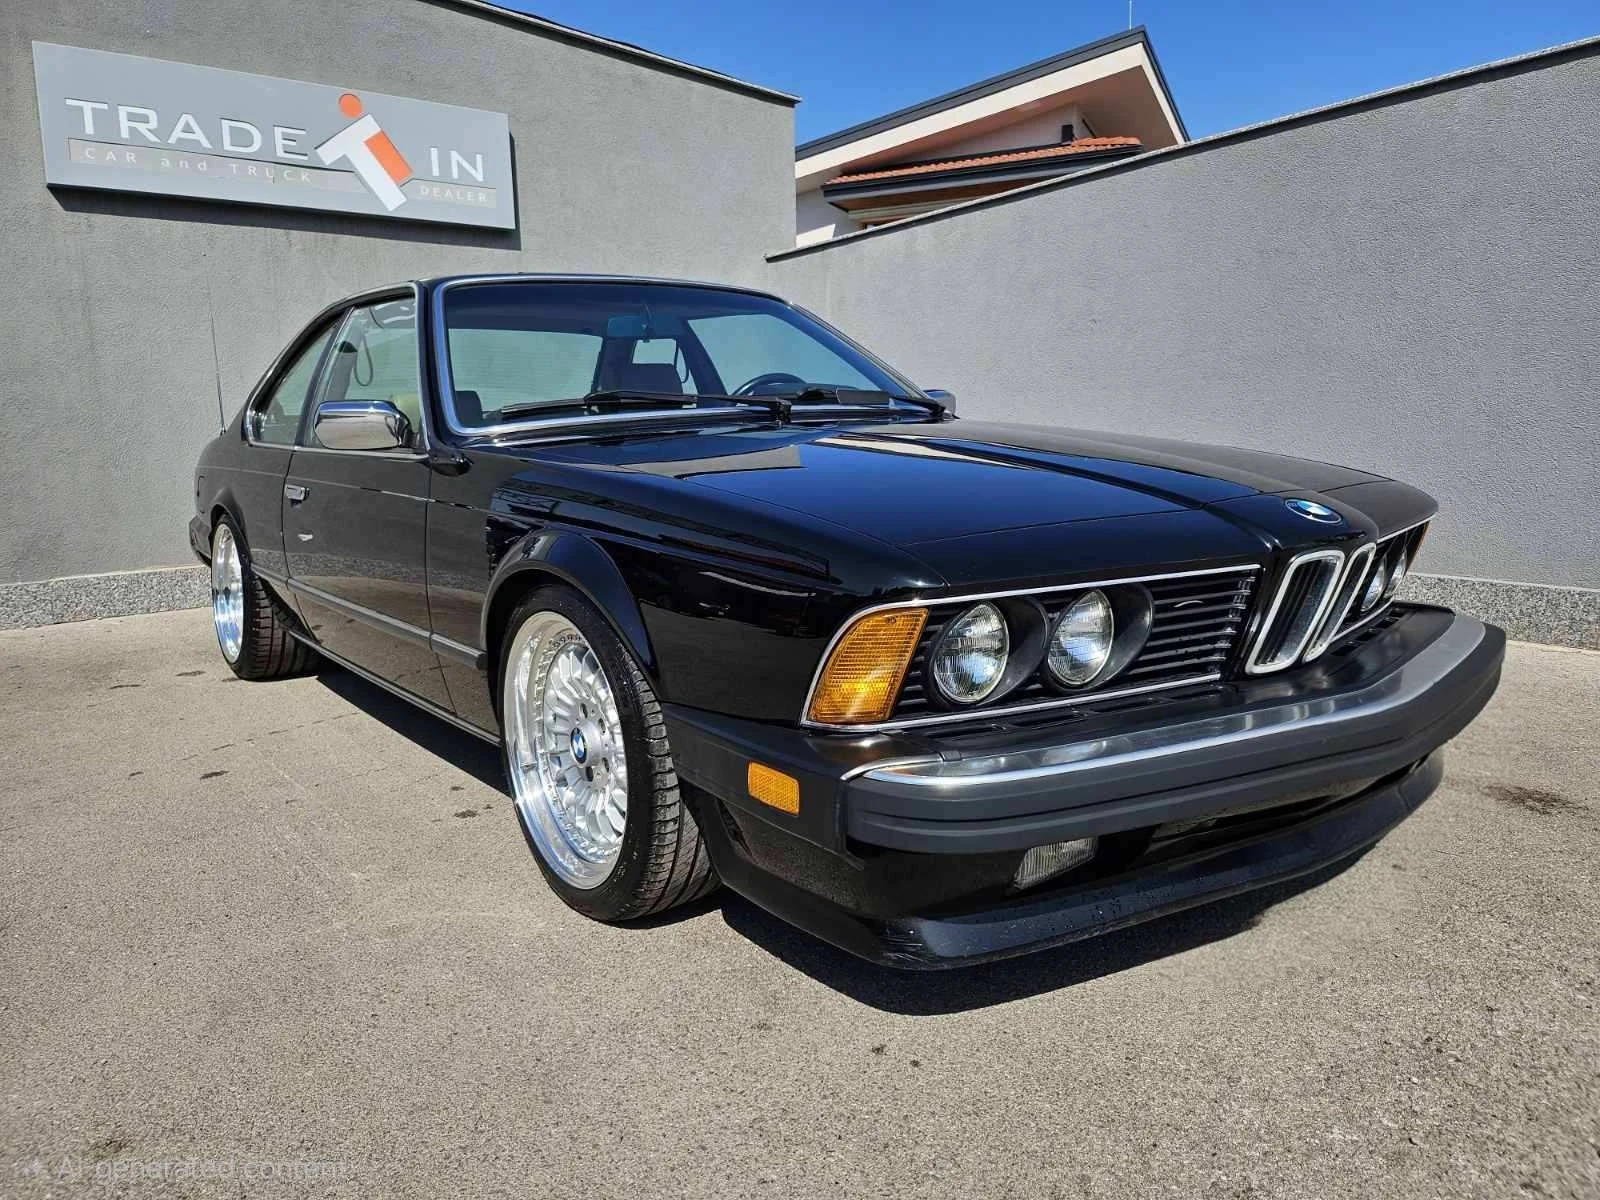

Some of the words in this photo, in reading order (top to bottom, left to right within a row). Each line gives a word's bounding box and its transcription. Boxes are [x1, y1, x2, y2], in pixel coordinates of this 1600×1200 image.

[65, 98, 309, 161] TRADE
[430, 146, 484, 182] IN
[85, 148, 137, 163] CAR
[161, 156, 208, 171] and
[231, 163, 312, 183] TRUCK
[419, 185, 489, 203] DEALER
